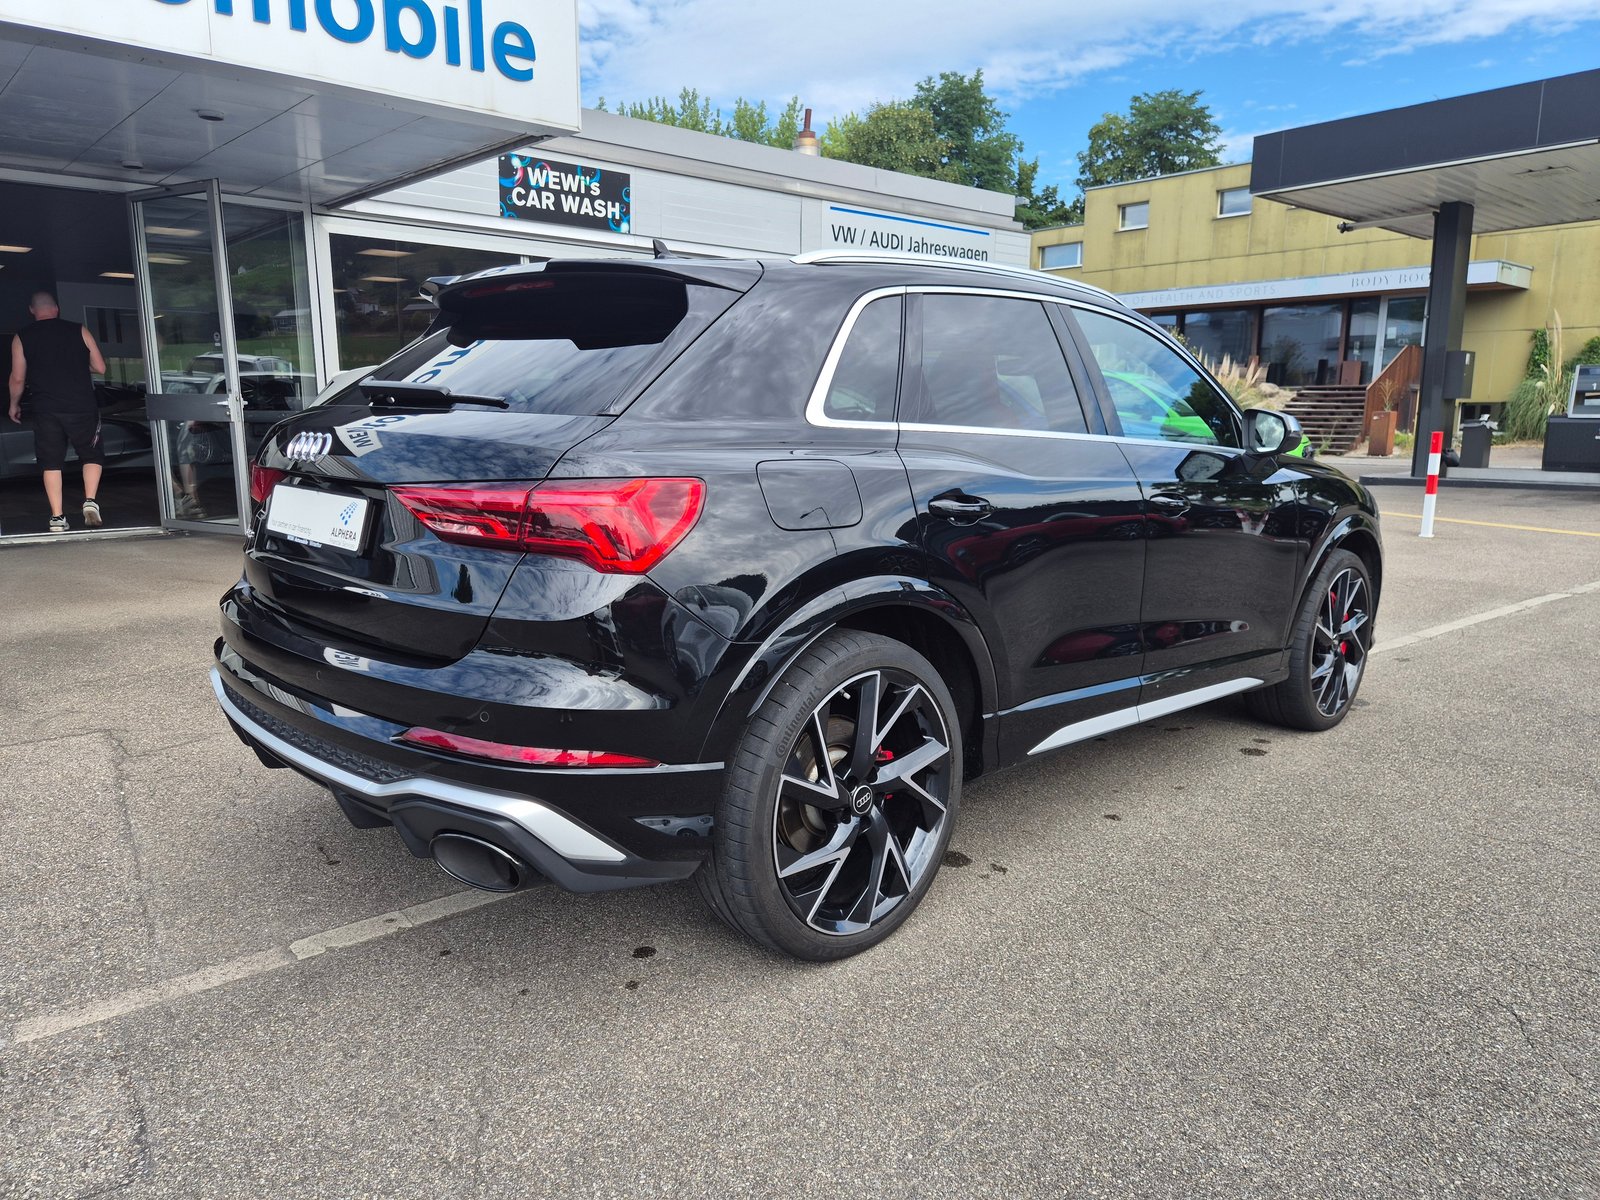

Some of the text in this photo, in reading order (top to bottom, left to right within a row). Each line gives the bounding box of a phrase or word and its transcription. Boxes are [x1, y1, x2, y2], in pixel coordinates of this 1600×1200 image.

[154, 0, 536, 82] obile
[527, 166, 600, 196] WEWi's
[511, 187, 620, 219] CAR WASH
[831, 224, 988, 262] VW / AUDI Jahreswagen
[1151, 292, 1193, 304] HEALTH
[1199, 289, 1224, 300] AND
[1230, 285, 1276, 298] SPORTS
[1351, 275, 1392, 287] BODY
[330, 527, 357, 541] ALPHERA
[775, 691, 818, 758] Continental
